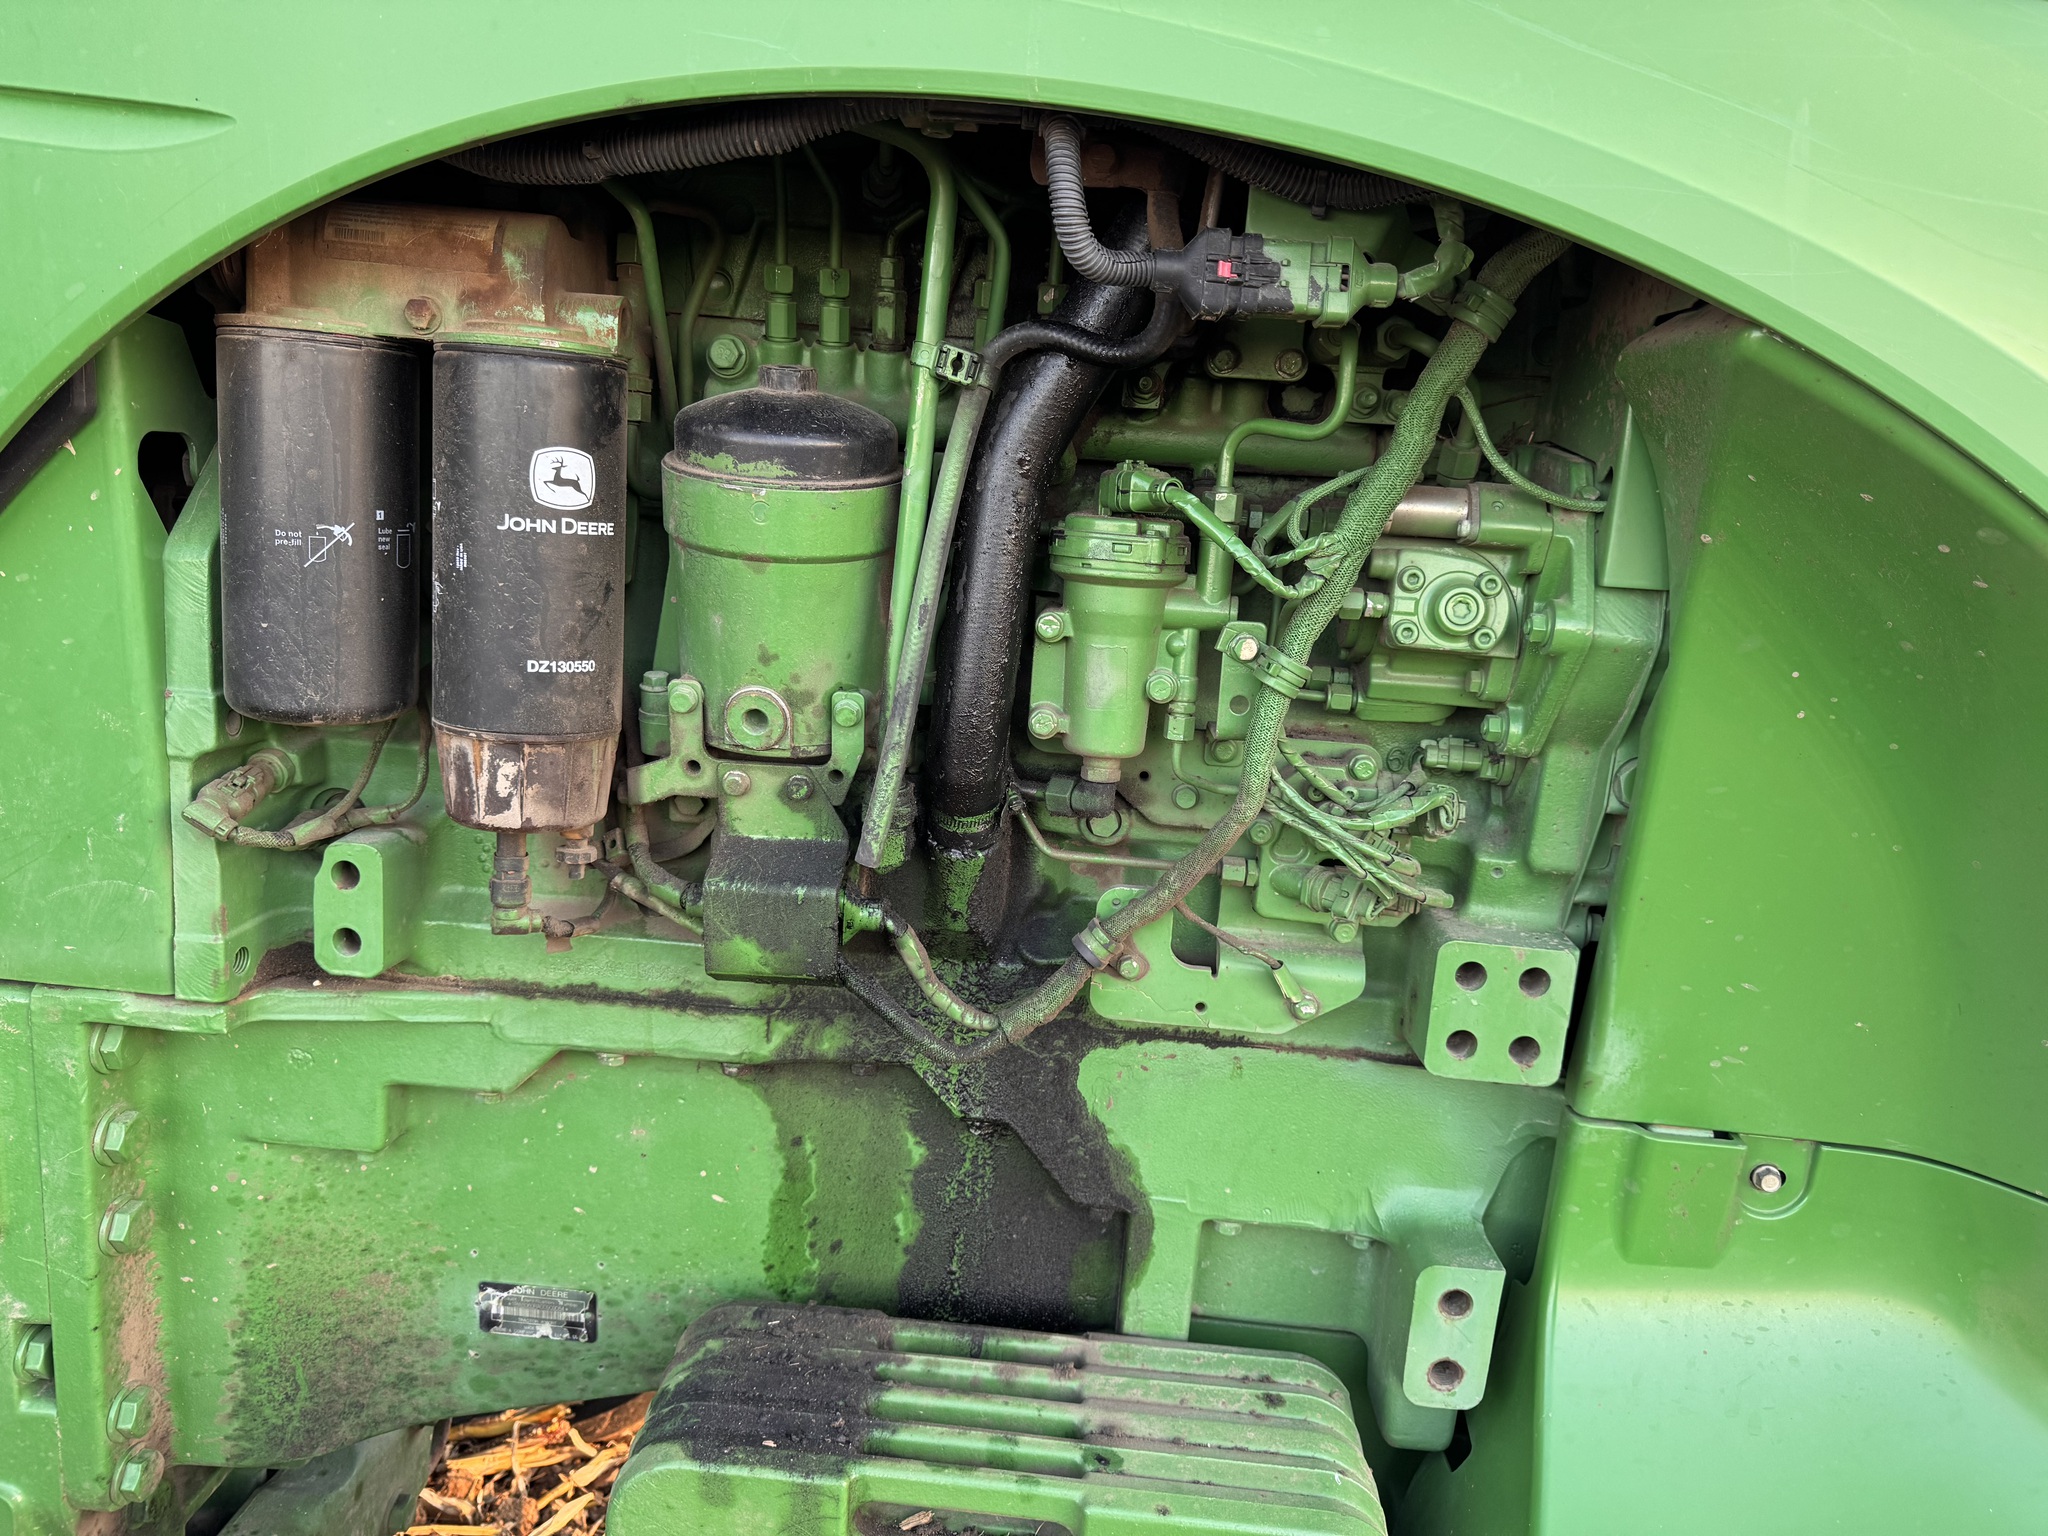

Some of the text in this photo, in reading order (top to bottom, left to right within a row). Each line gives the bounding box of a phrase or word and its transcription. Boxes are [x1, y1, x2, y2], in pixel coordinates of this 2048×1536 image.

[496, 513, 615, 536] JOHN DEERE
[275, 529, 302, 538] Do not
[378, 527, 392, 535] Lube
[275, 538, 302, 547] pre-fill
[378, 543, 391, 551] seal
[527, 659, 596, 673] DZ130550
[540, 1289, 569, 1299] DEERE
